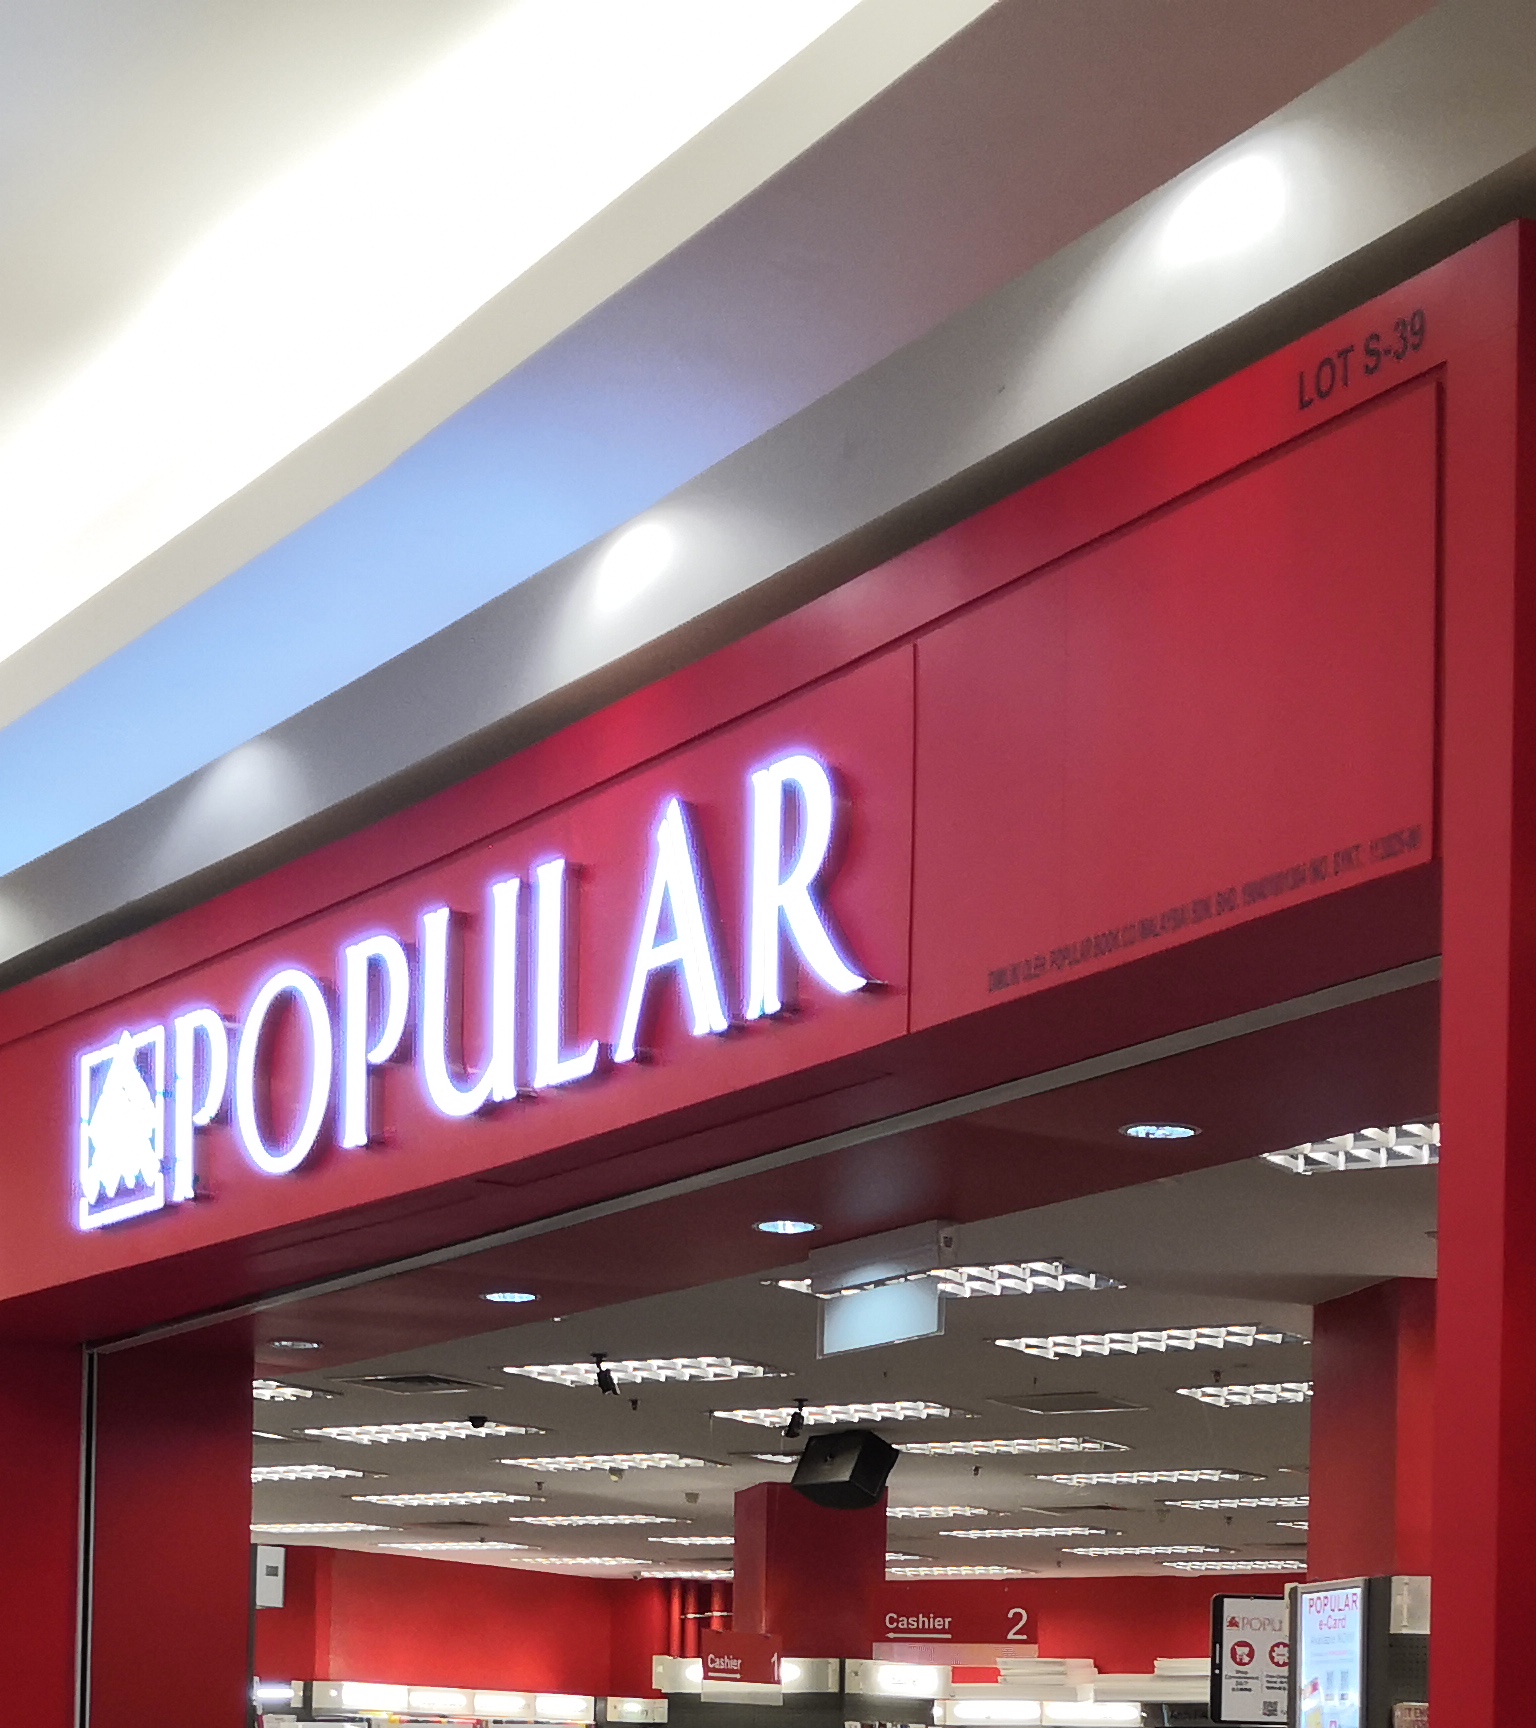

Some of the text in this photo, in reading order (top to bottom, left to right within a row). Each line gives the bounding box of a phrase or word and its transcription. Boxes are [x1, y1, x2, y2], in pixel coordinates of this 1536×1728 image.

[1298, 308, 1426, 411] LOT S-39
[174, 754, 868, 1202] POPULAR
[1308, 1592, 1359, 1615] POPULAR
[885, 1607, 1028, 1640] Cashier 2
[1241, 1616, 1283, 1632] POPU
[1318, 1614, 1347, 1631] e-Card
[707, 1651, 779, 1681] Cashier 1
